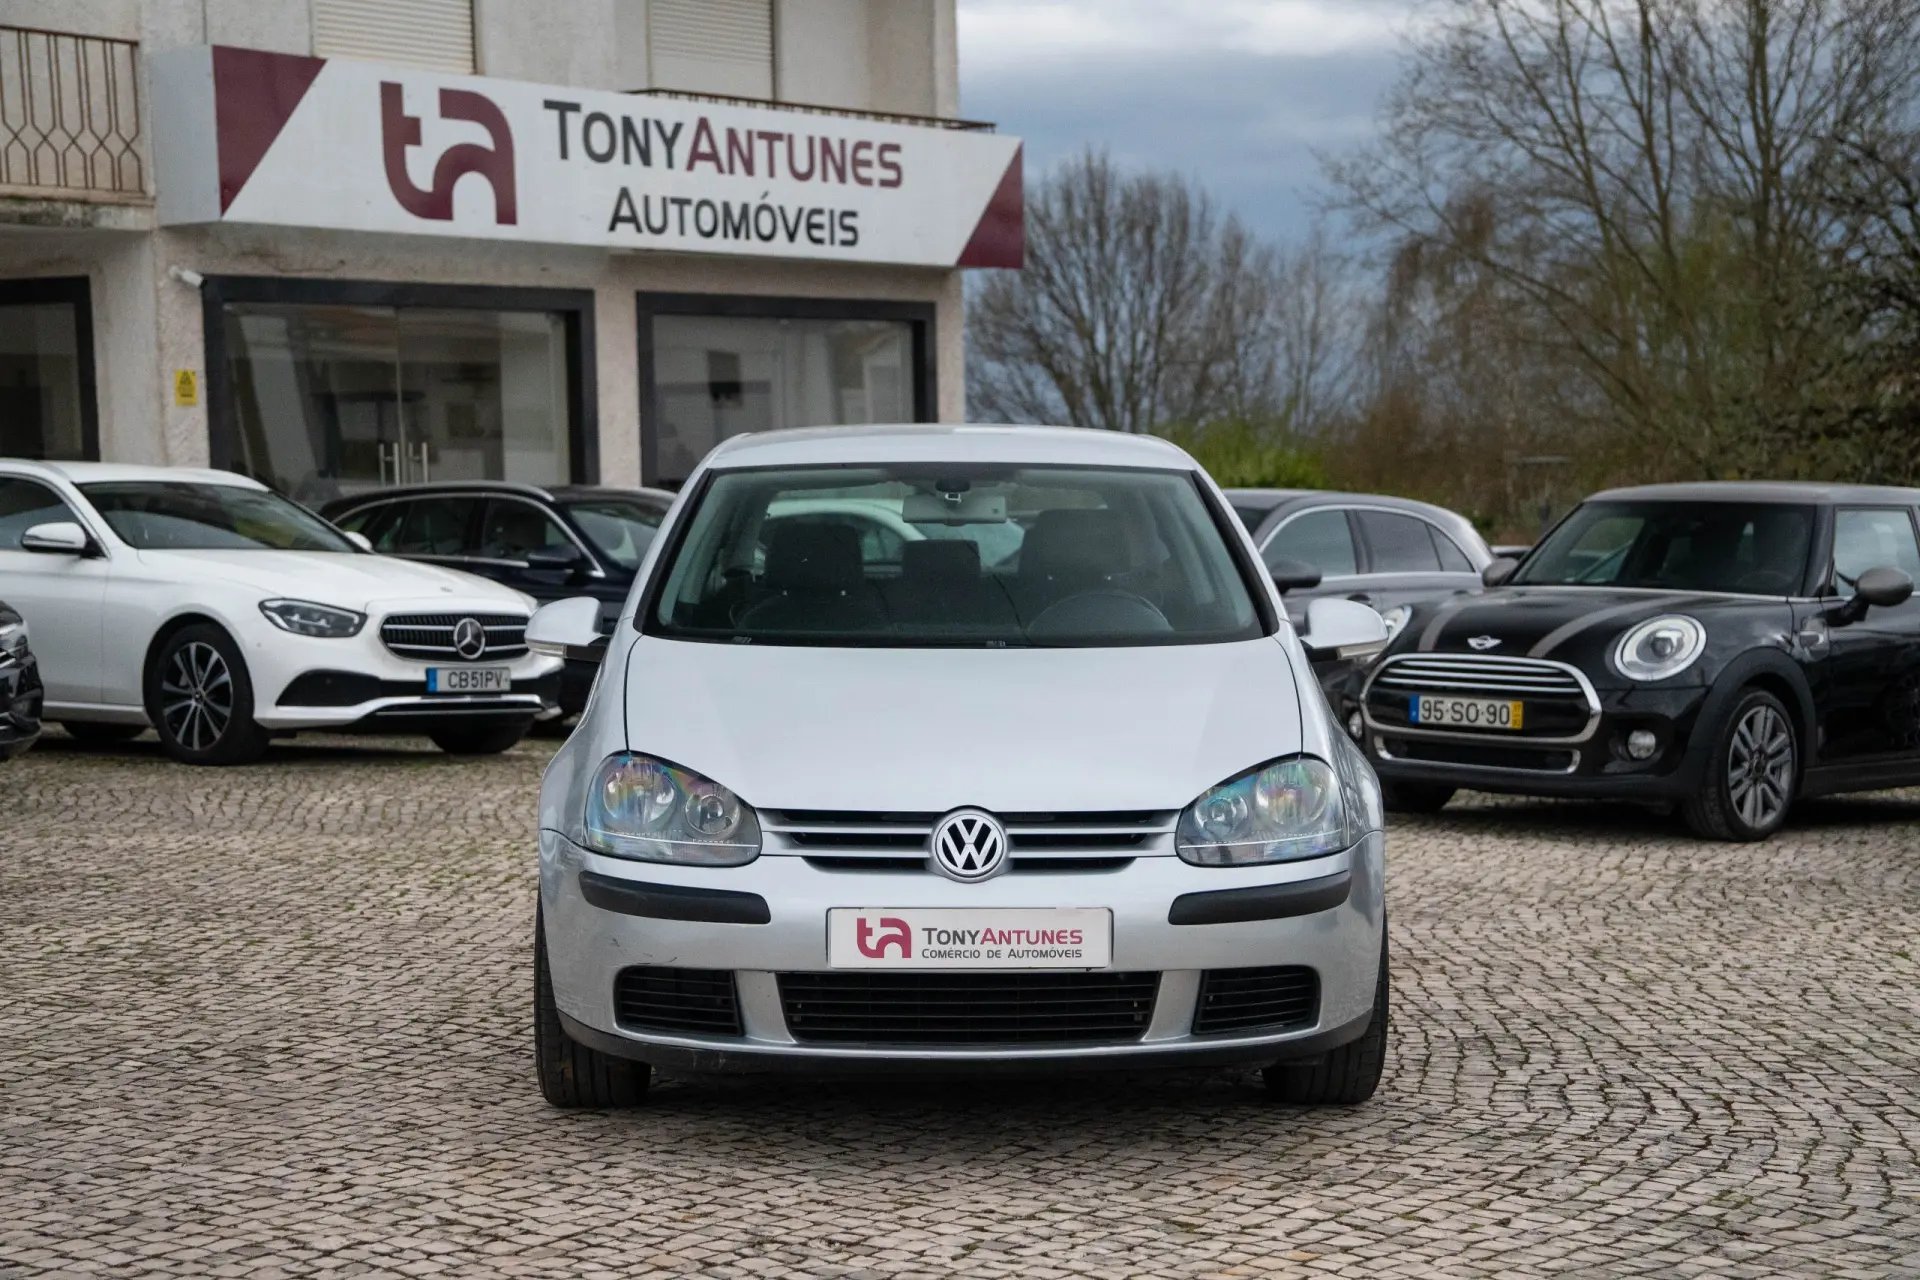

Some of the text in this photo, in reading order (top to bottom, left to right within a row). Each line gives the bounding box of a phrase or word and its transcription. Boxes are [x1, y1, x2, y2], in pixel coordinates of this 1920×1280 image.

[608, 187, 860, 247] AUTOMÓVEIS
[922, 946, 1082, 959] COMÉRCIO DE AUTOMÓVEIS
